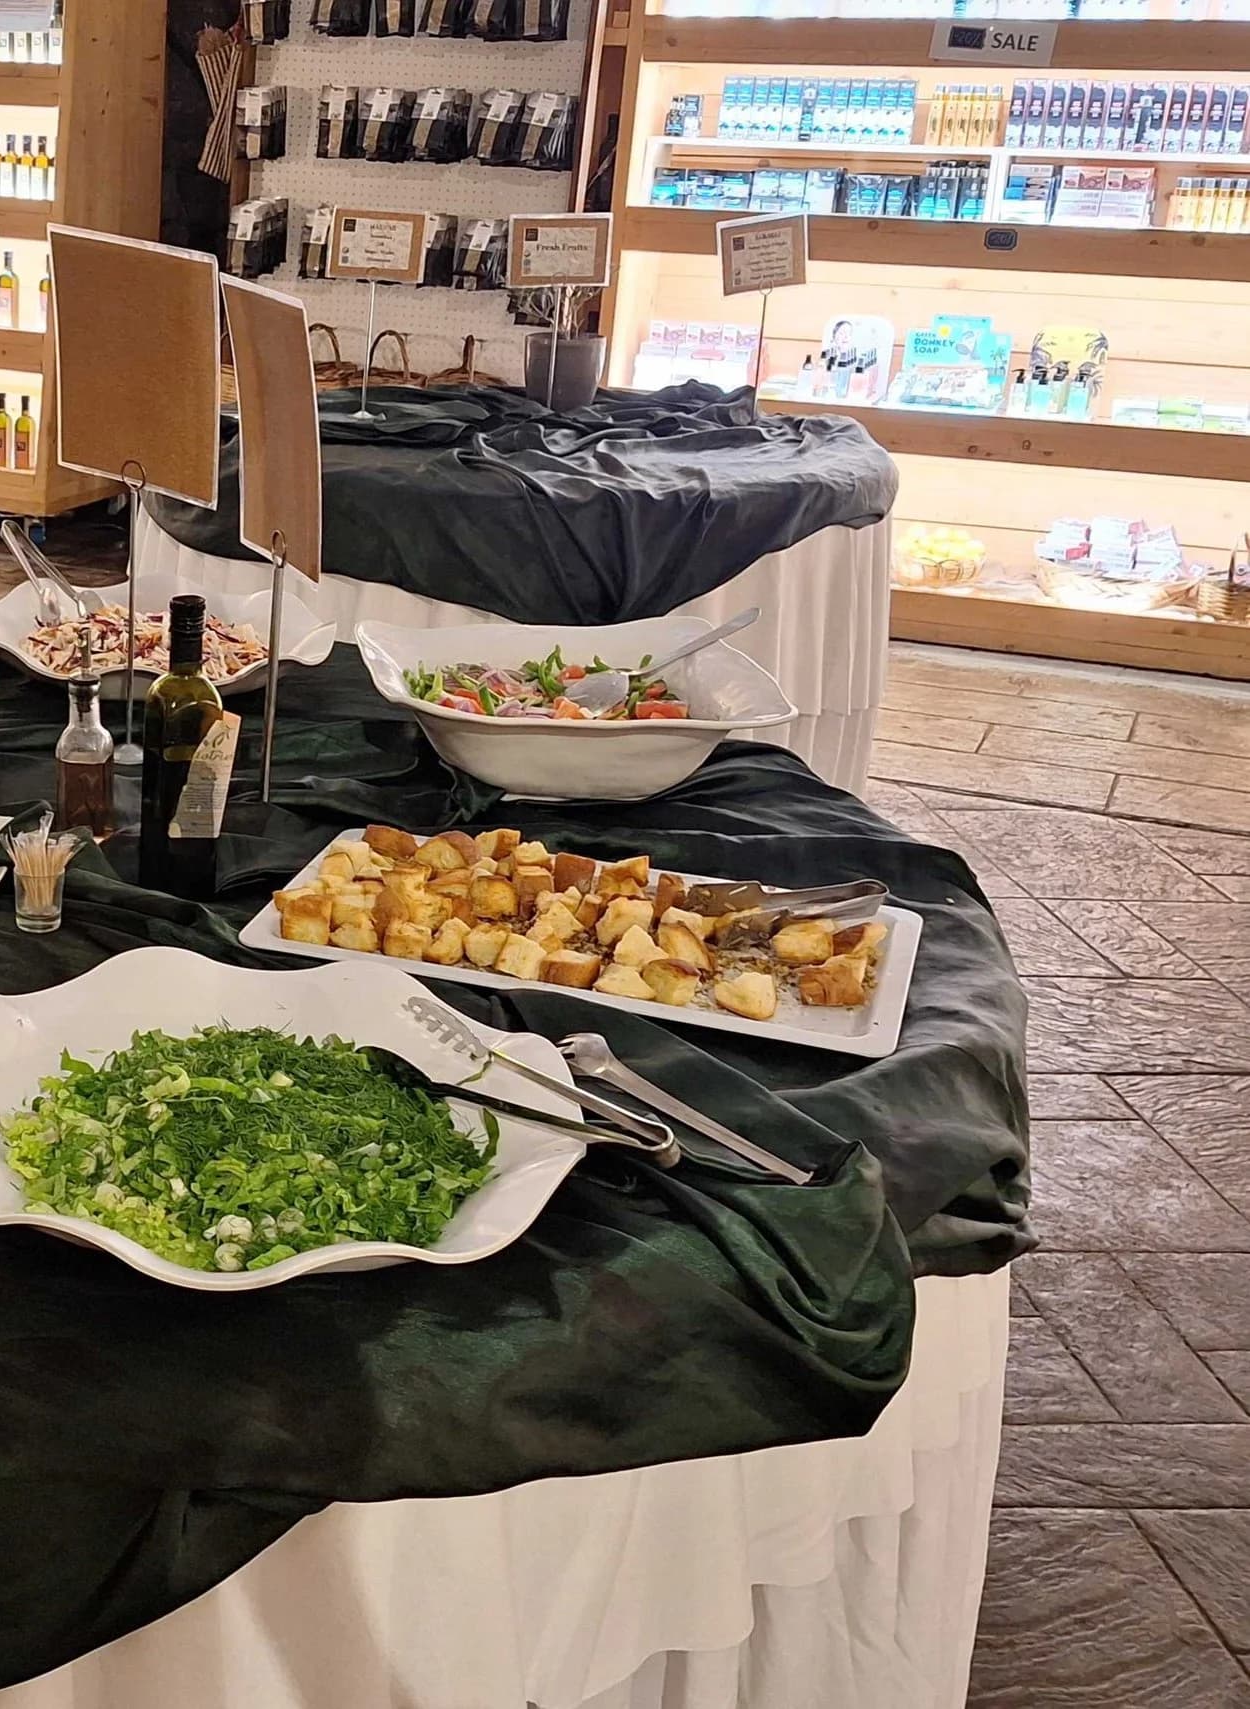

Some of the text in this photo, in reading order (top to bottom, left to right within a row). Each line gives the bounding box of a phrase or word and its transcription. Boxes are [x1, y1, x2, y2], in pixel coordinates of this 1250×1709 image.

[991, 32, 1039, 52] SALE
[536, 242, 589, 252] Fresh Fruits
[914, 337, 956, 348] DONKEY
[913, 345, 940, 354] SOAP
